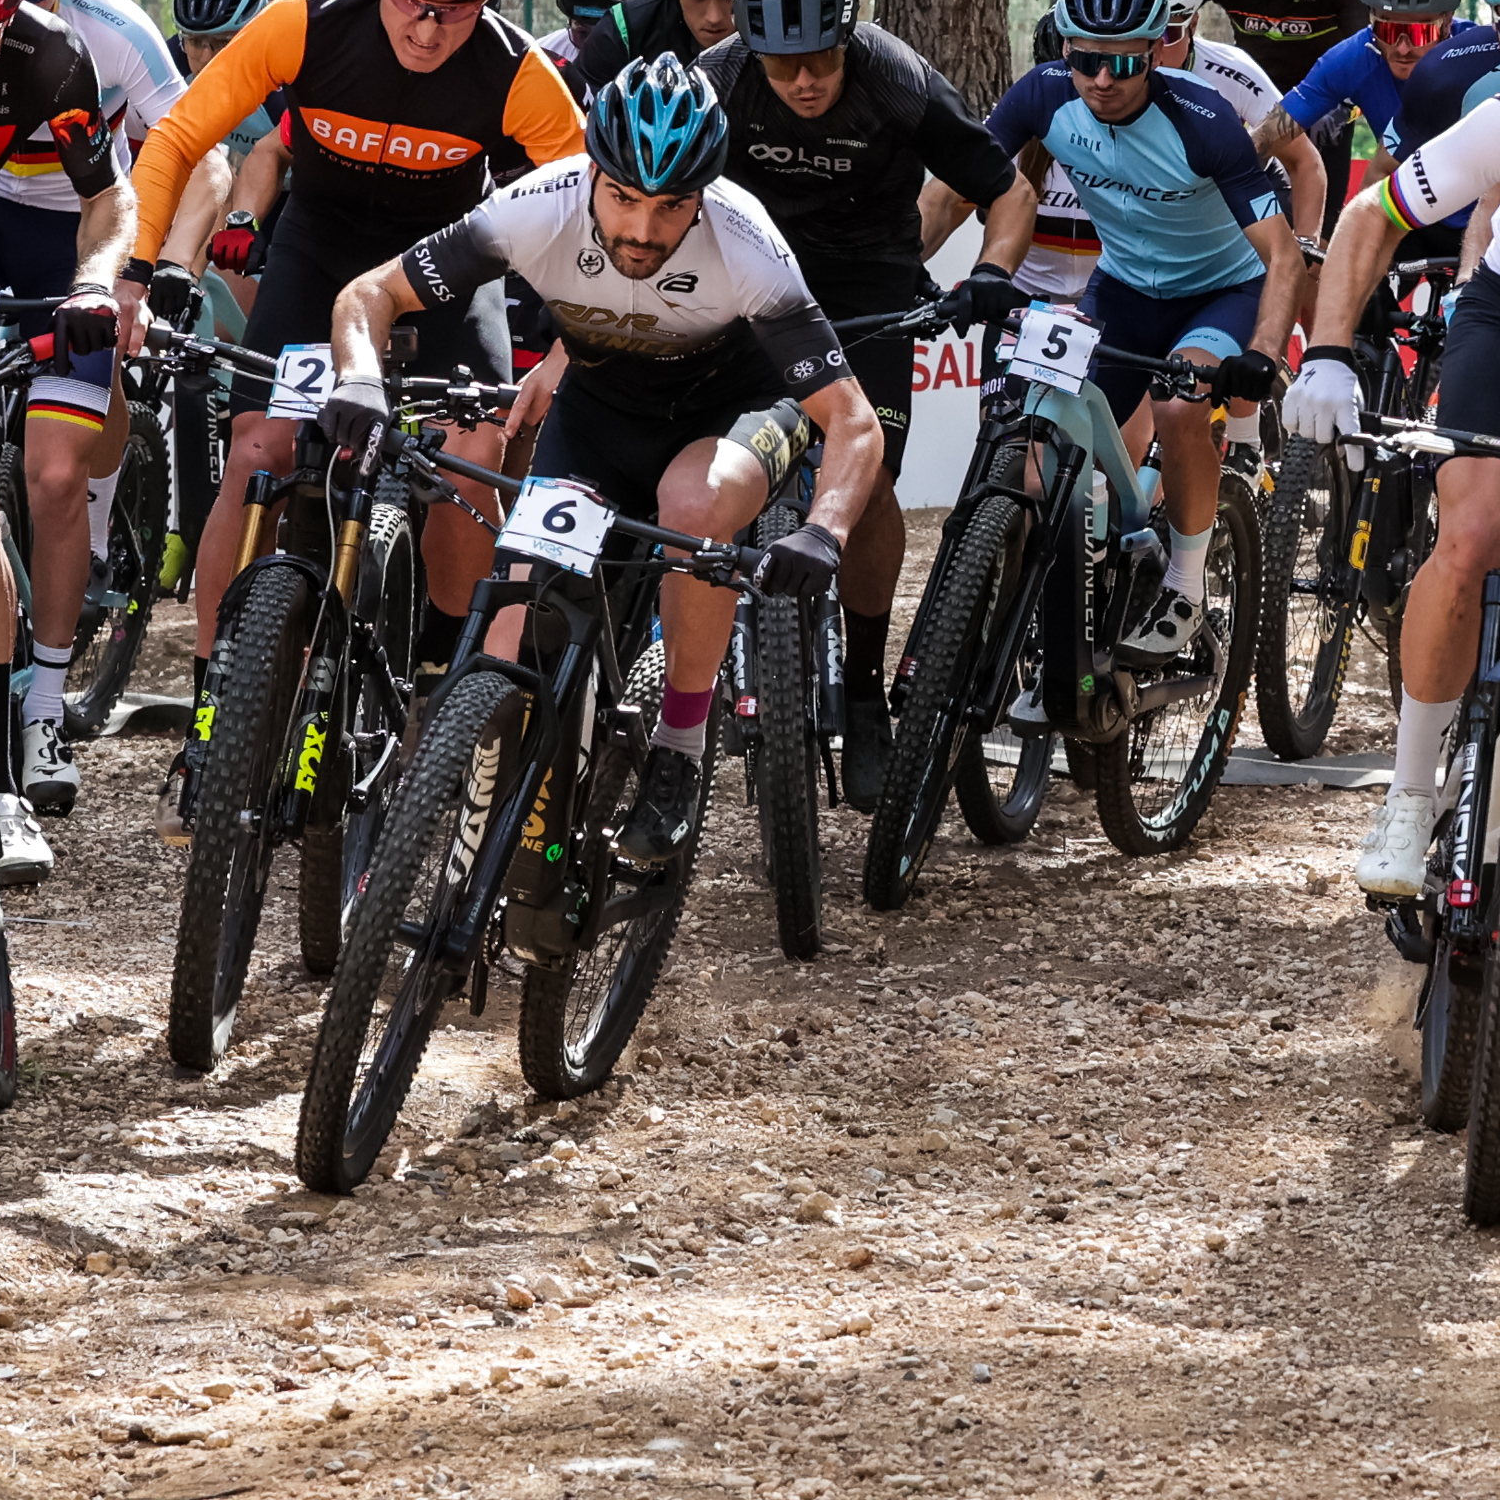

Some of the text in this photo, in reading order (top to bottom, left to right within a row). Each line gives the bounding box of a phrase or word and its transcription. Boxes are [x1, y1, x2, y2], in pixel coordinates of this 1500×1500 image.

[4, 37, 35, 55] IMANO
[1204, 59, 1265, 98] TREK
[312, 118, 468, 161] BAFANG
[415, 247, 456, 302] SWISS
[1041, 324, 1073, 360] 5
[542, 499, 578, 534] 6
